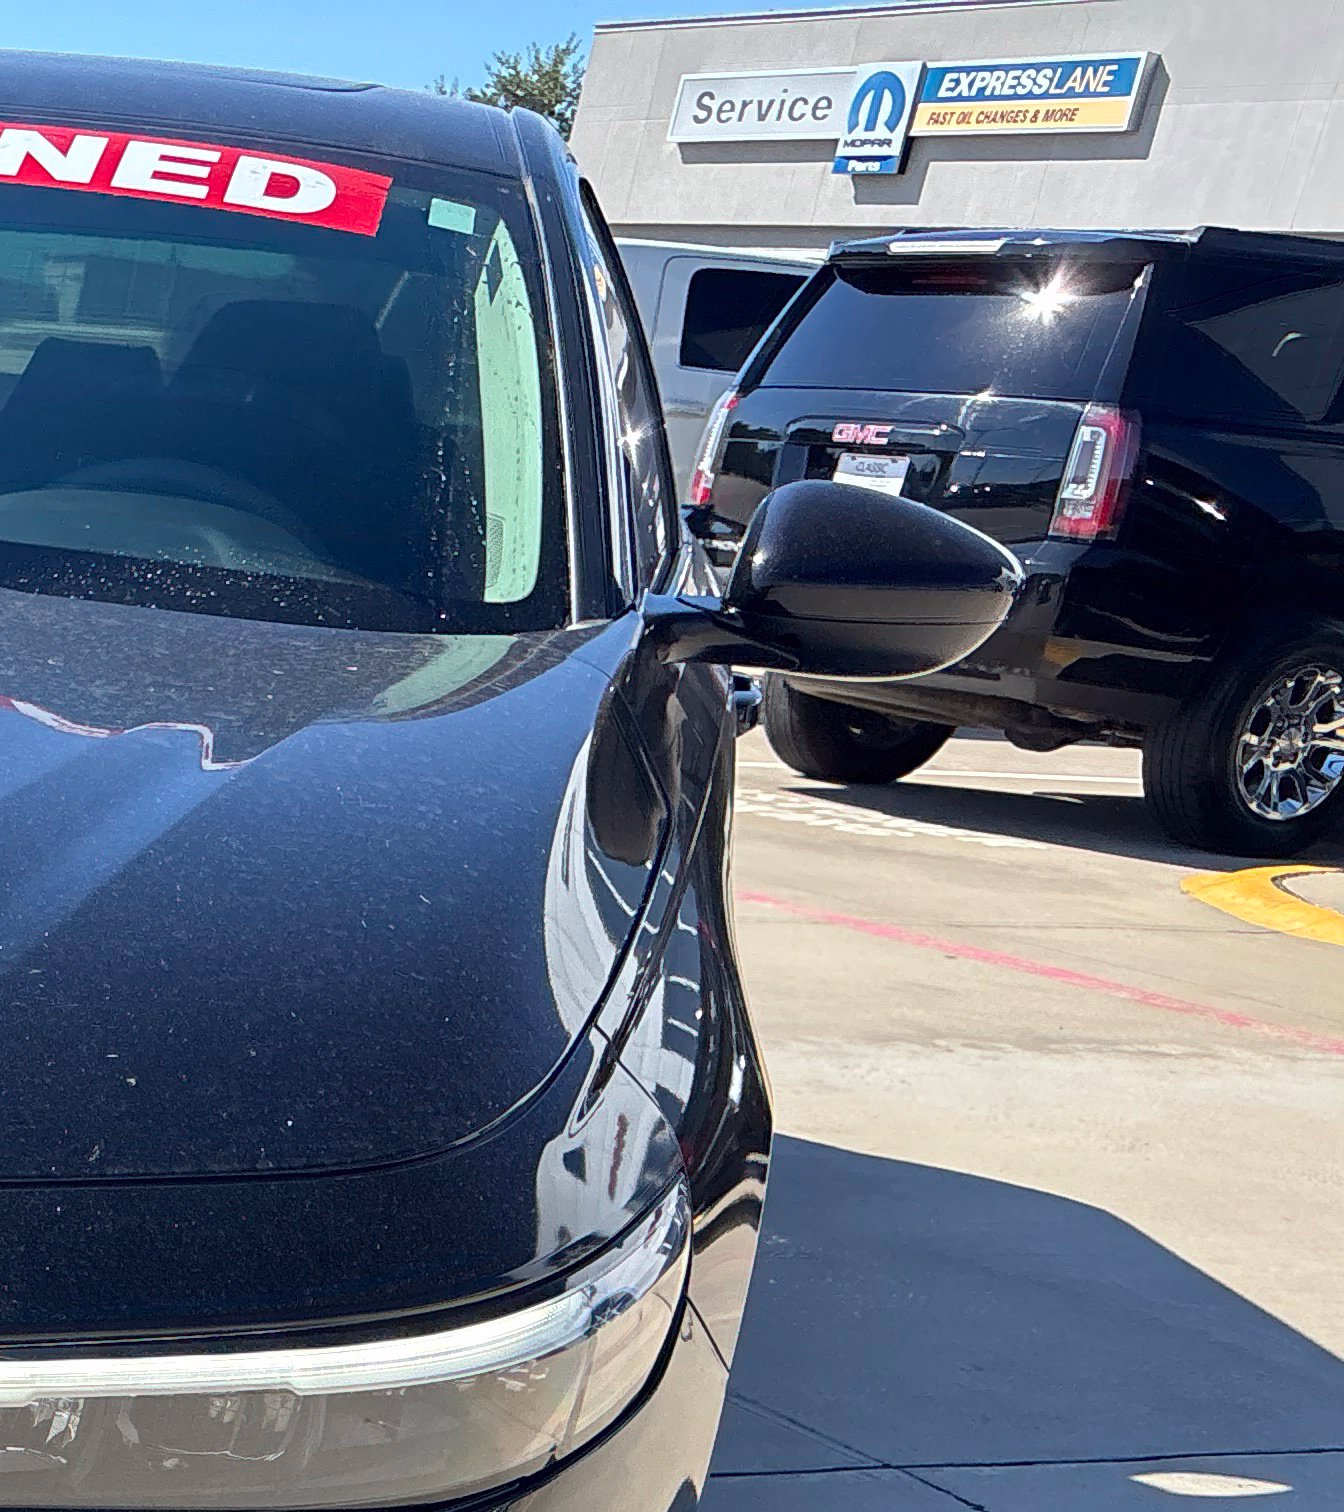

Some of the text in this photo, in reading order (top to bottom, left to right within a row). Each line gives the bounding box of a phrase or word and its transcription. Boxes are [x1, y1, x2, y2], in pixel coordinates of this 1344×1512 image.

[936, 64, 1119, 98] EXPRESSLANE
[692, 87, 833, 126] Service
[926, 107, 1080, 126] FAST OIL CHANGES & MORE
[842, 138, 893, 149] MOPAR
[831, 423, 895, 445] GMC
